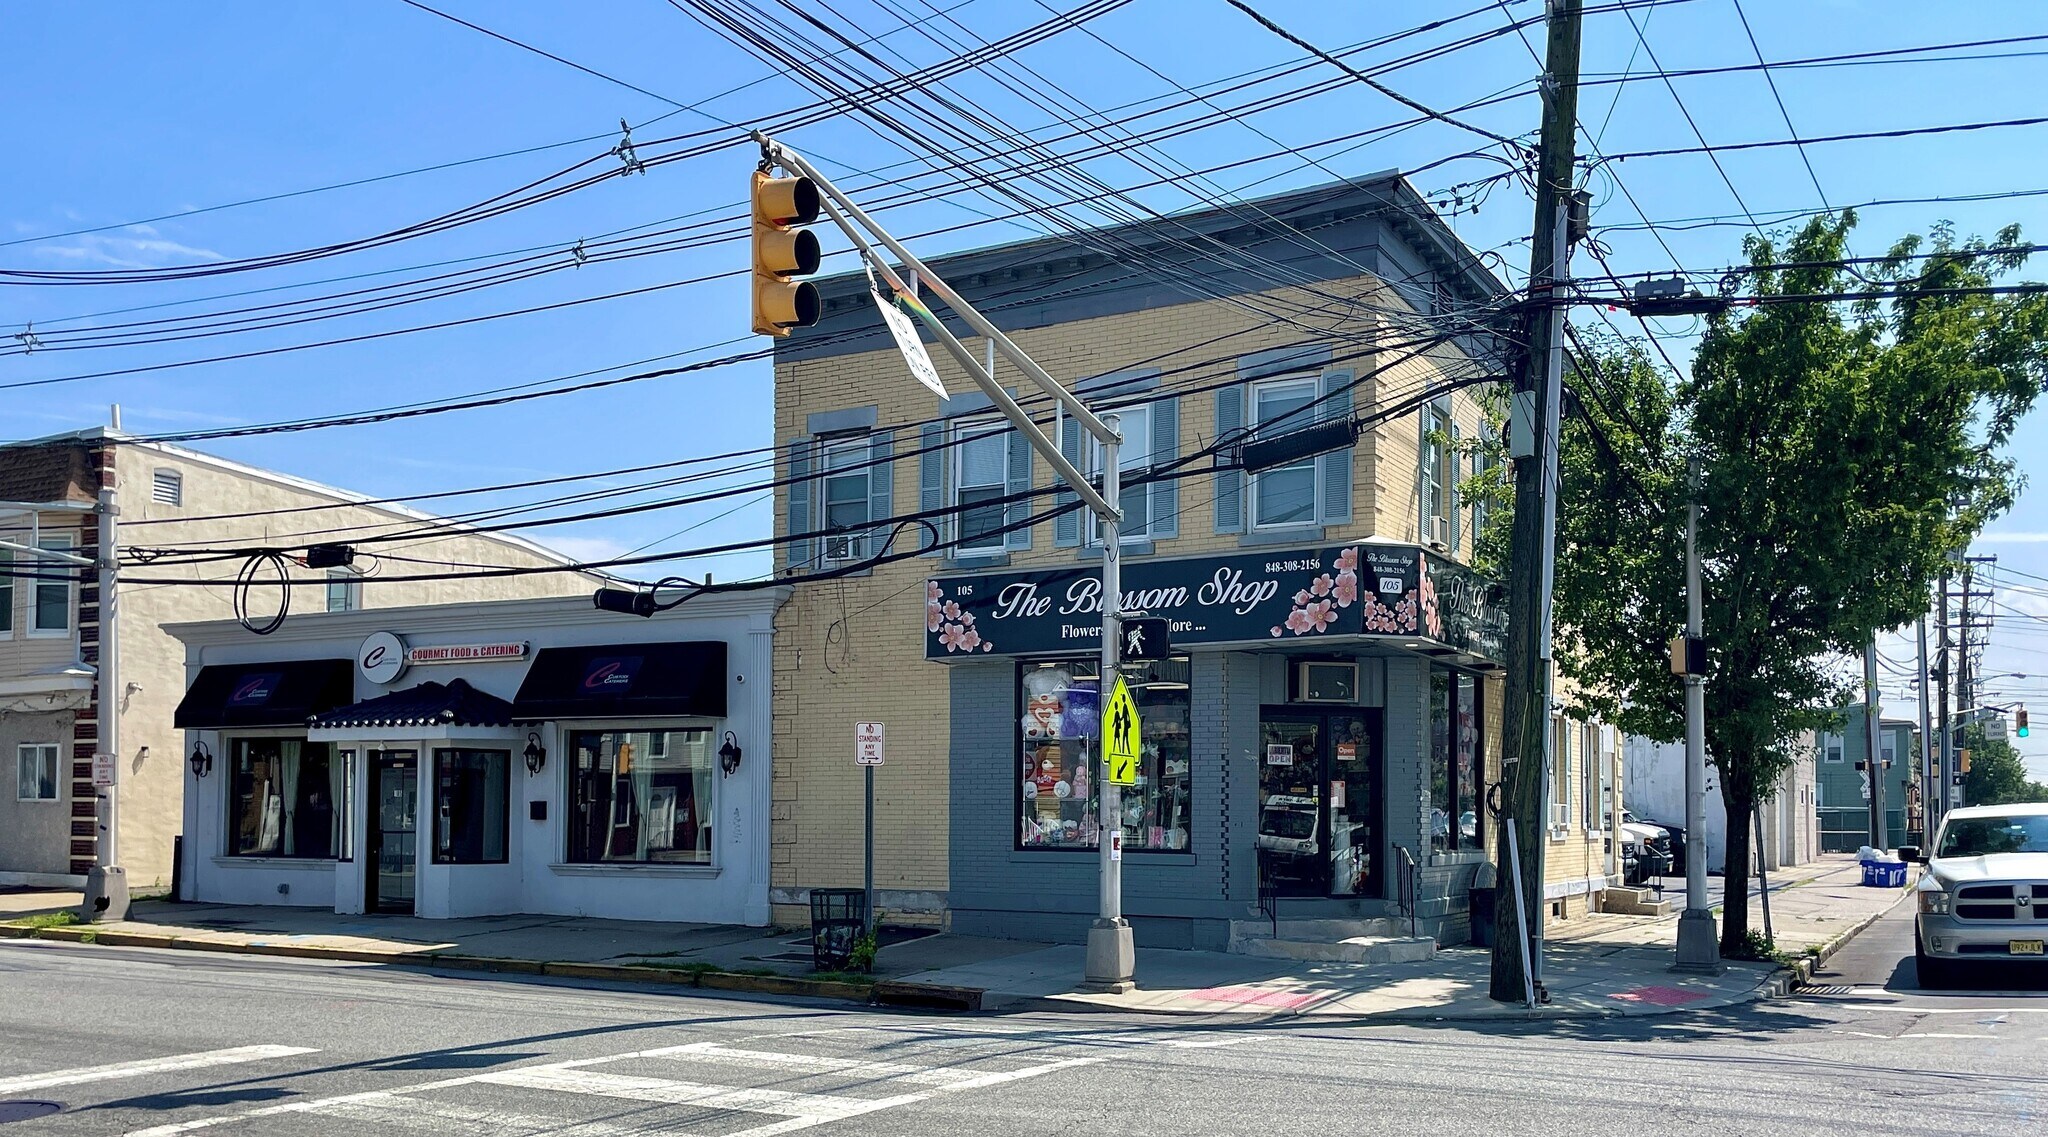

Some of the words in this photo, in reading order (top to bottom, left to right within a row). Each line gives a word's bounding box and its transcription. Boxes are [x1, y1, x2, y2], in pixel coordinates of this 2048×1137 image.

[1265, 558, 1321, 573] 848-308-2156
[957, 585, 973, 596] 105
[992, 582, 1051, 619] The
[1059, 577, 1189, 615] Bssom
[1197, 566, 1279, 615] Shop
[1382, 581, 1399, 590] 105
[1449, 575, 1470, 614] The
[412, 649, 448, 660] GOURMET
[450, 647, 471, 658] FOOD
[473, 648, 479, 657] &
[480, 645, 520, 656] CATERING
